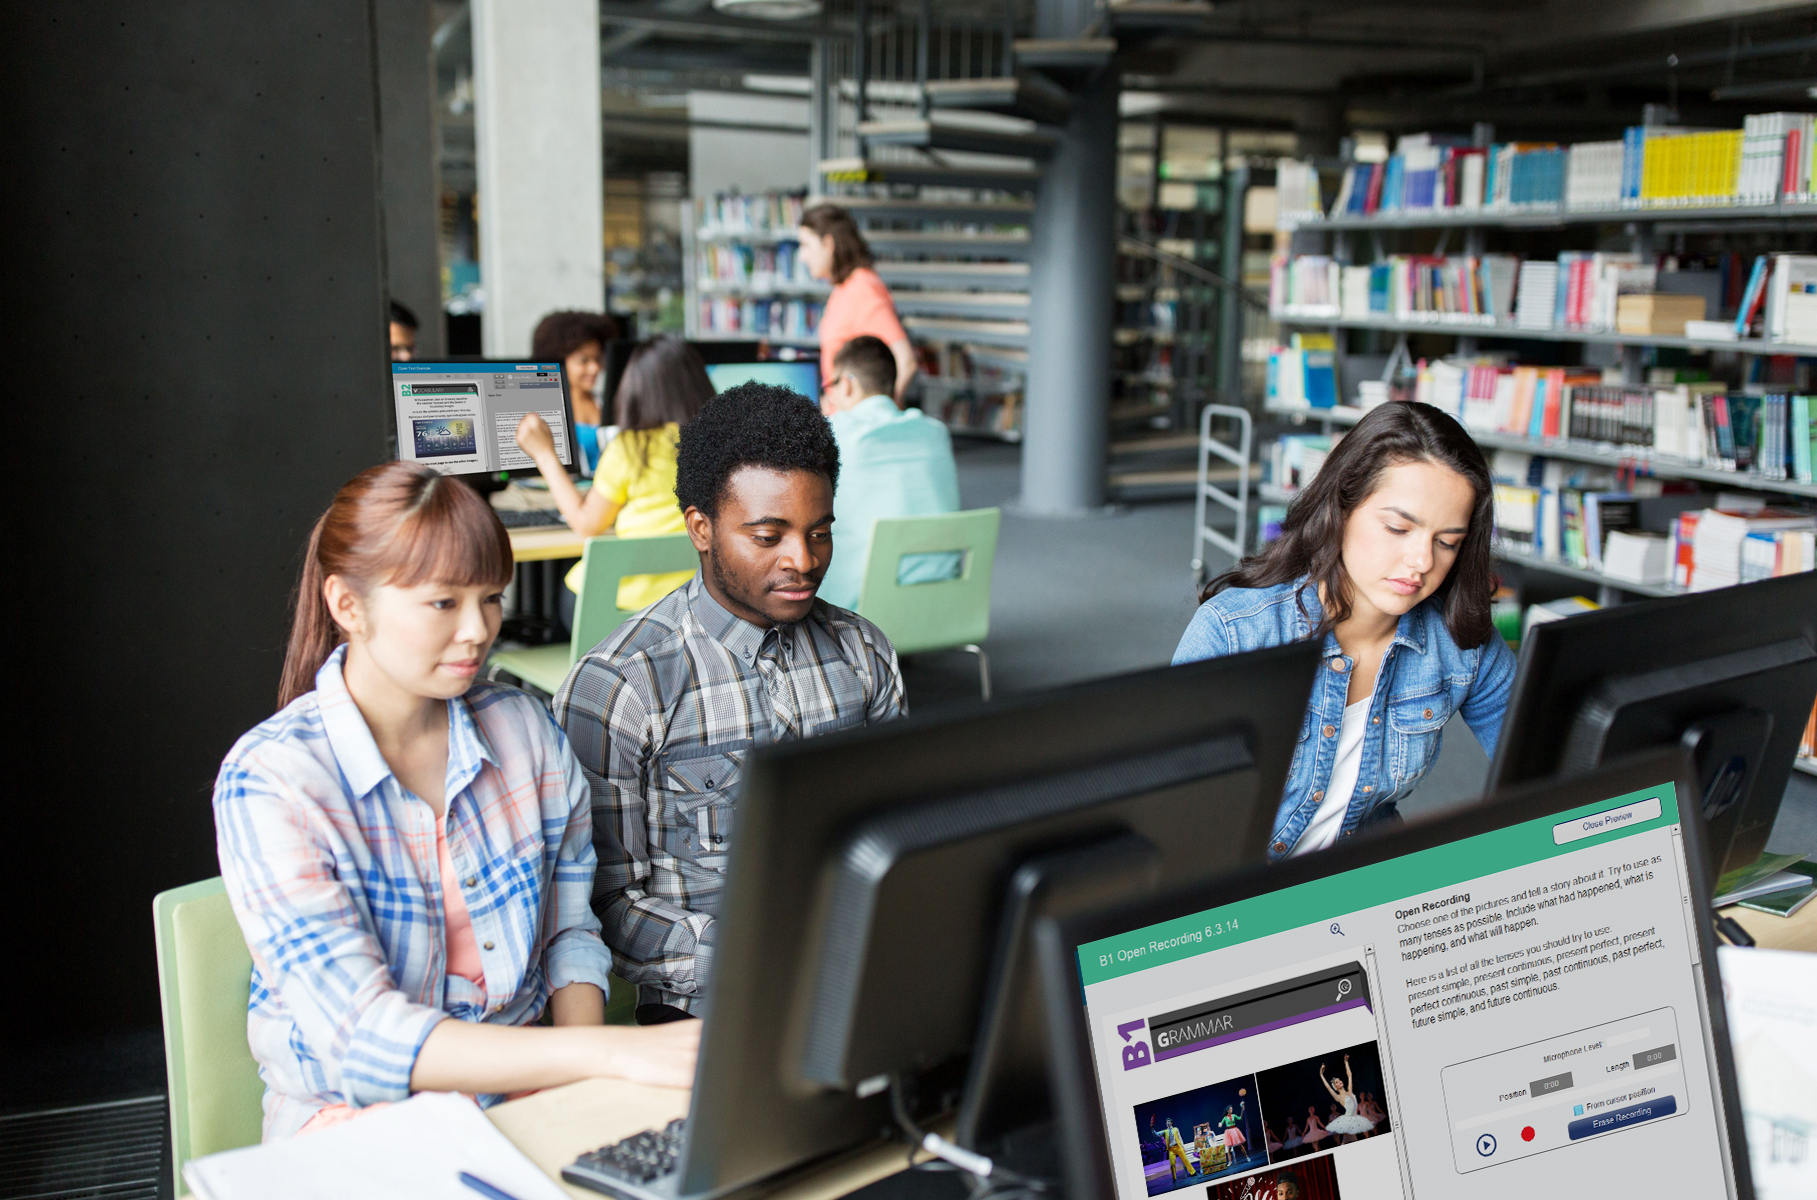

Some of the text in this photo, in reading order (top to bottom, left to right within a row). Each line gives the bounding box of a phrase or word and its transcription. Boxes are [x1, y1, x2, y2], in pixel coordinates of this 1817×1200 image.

[400, 384, 411, 397] B2
[1582, 812, 1633, 831] Close Preview
[1394, 893, 1471, 920] Open Recording
[1397, 918, 1432, 934] Choose
[1432, 914, 1450, 925] one
[1450, 908, 1459, 920] of
[1460, 907, 1475, 917] the
[1475, 897, 1510, 915] pictures
[1511, 890, 1528, 903] and
[1528, 886, 1542, 898] tell
[1542, 886, 1549, 895] a
[1550, 880, 1571, 892] story
[1572, 871, 1598, 886] about
[1607, 866, 1622, 877] Try
[1622, 863, 1633, 873] to
[1633, 858, 1650, 870] use
[1650, 855, 1663, 865] as
[1399, 935, 1423, 948] many
[1423, 926, 1453, 942] tenses
[1453, 923, 1466, 934] as
[1505, 903, 1537, 919] Include
[1536, 897, 1558, 910] what
[1558, 891, 1576, 905] had
[1576, 878, 1623, 899] happened,
[1623, 873, 1645, 887] what
[1645, 870, 1654, 881] is
[1099, 918, 1239, 967] B1 Open Recording 6.3.14
[1401, 917, 1539, 962] happening, and what will happen.
[1405, 976, 1428, 989] Here
[1428, 973, 1437, 982] is
[1438, 971, 1445, 980] a
[1445, 966, 1459, 978] list
[1459, 962, 1469, 974] of
[1469, 960, 1481, 971] all
[1480, 958, 1495, 968] the
[1495, 949, 1525, 964] tenses
[1525, 945, 1542, 958] you
[1542, 935, 1571, 951] should
[1571, 934, 1583, 943] try
[1583, 930, 1594, 940] to
[1408, 926, 1656, 1004] present simple, present continuous, present perfect, present
[1410, 939, 1666, 1018] perfect continuous, past simple, past continuous, past perfect,
[1411, 982, 1561, 1030] future simple, and future continuous.
[1117, 1018, 1152, 1072] B1
[1158, 1015, 1234, 1048] GRAMMAR
[1586, 1087, 1656, 1111] From cursor position
[1592, 1107, 1652, 1129] Erase Recording
